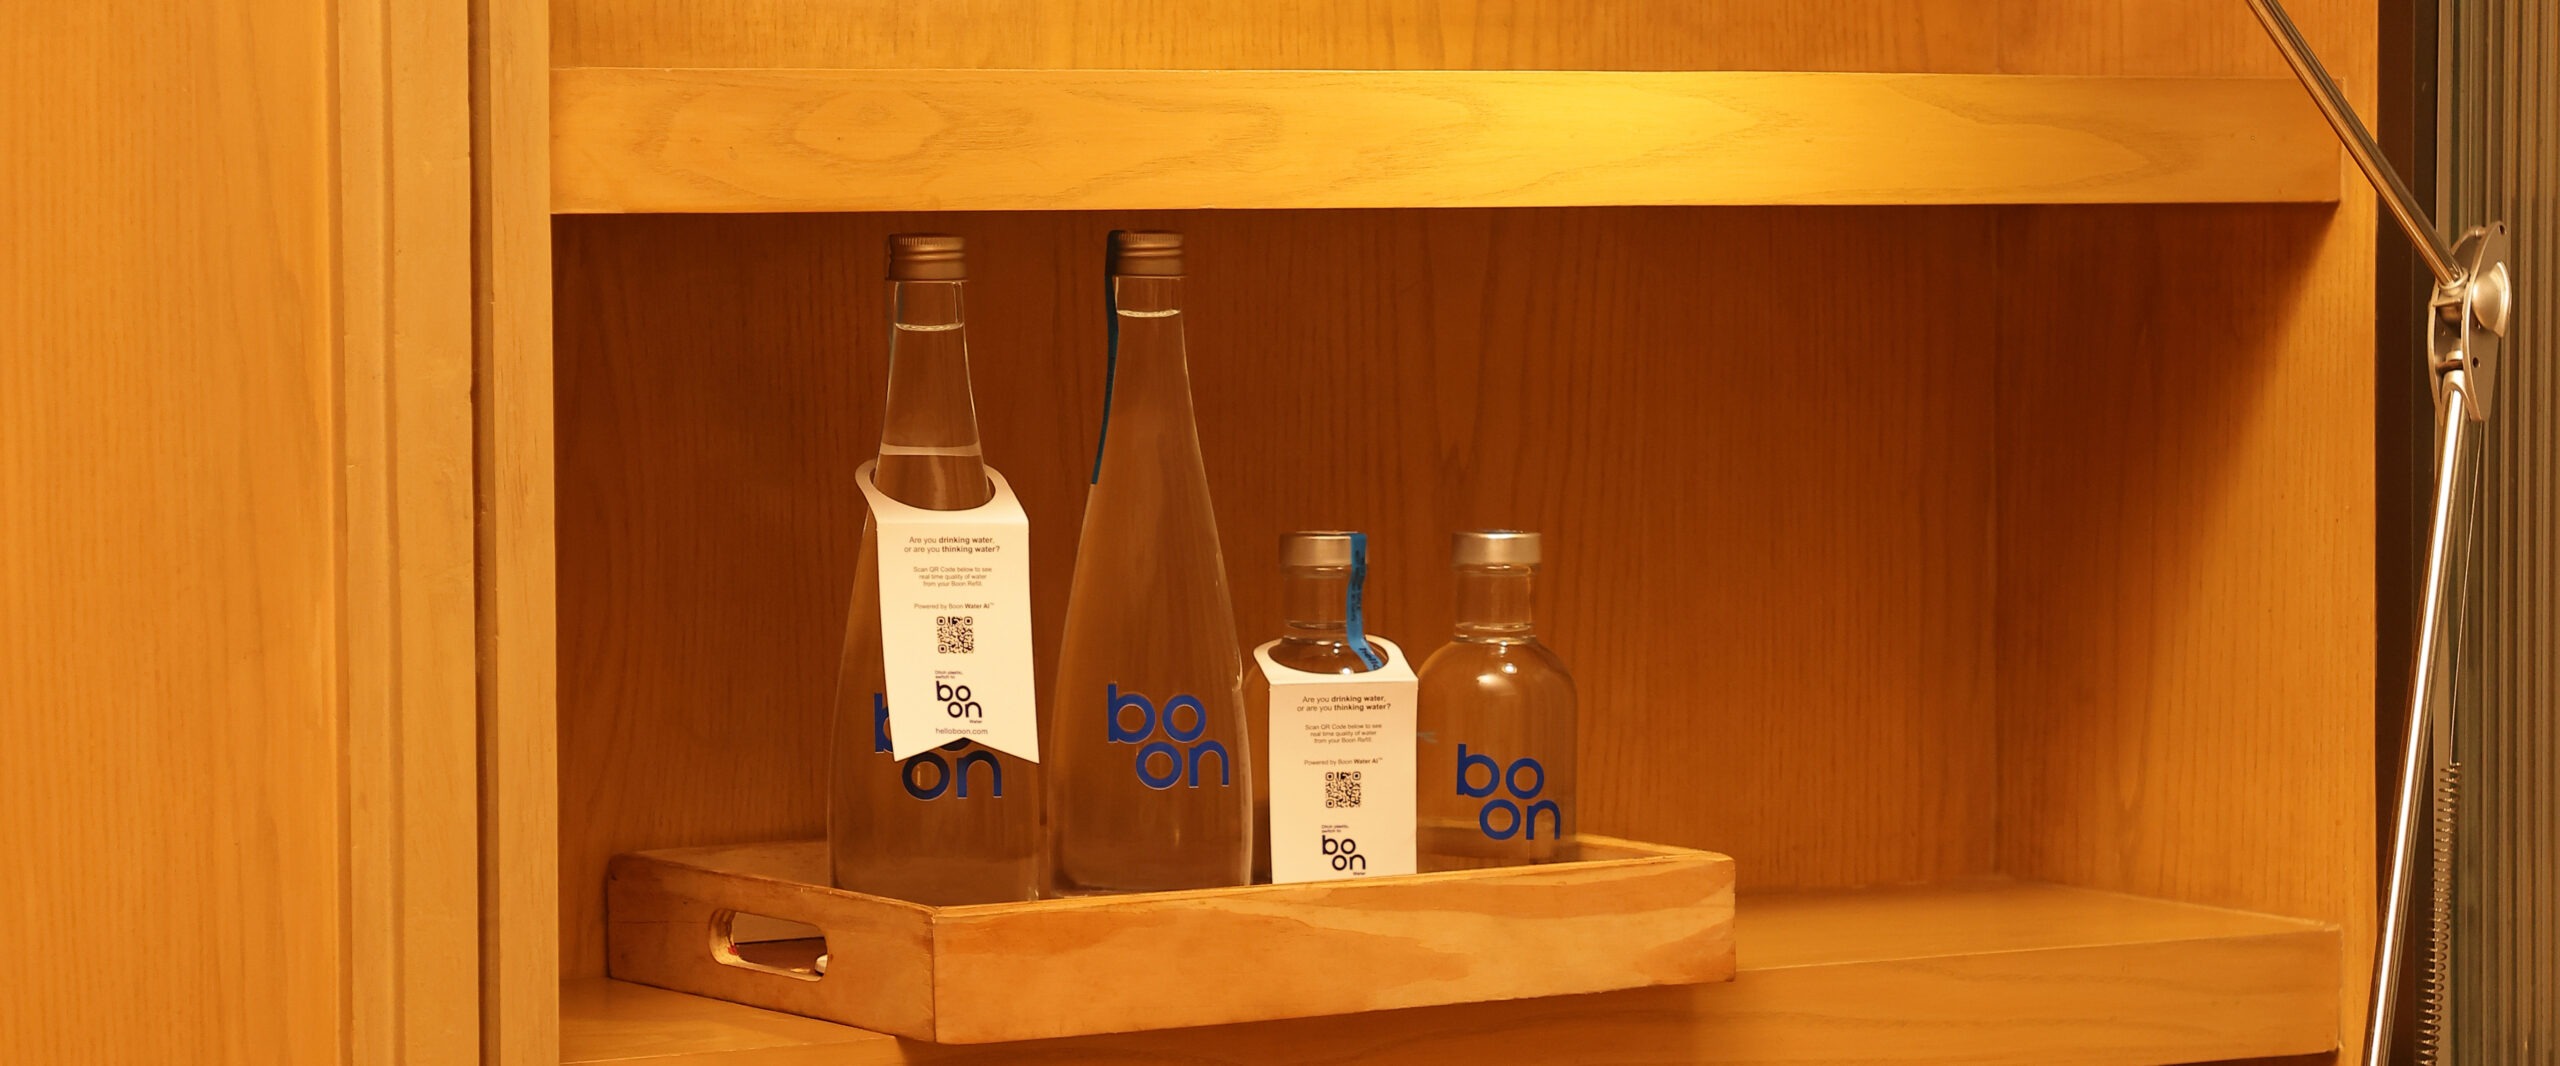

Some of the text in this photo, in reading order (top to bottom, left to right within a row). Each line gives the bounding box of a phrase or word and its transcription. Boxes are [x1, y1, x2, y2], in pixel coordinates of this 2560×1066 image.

[938, 536, 970, 545] drinking
[927, 546, 940, 554] you
[942, 546, 973, 554] thinking
